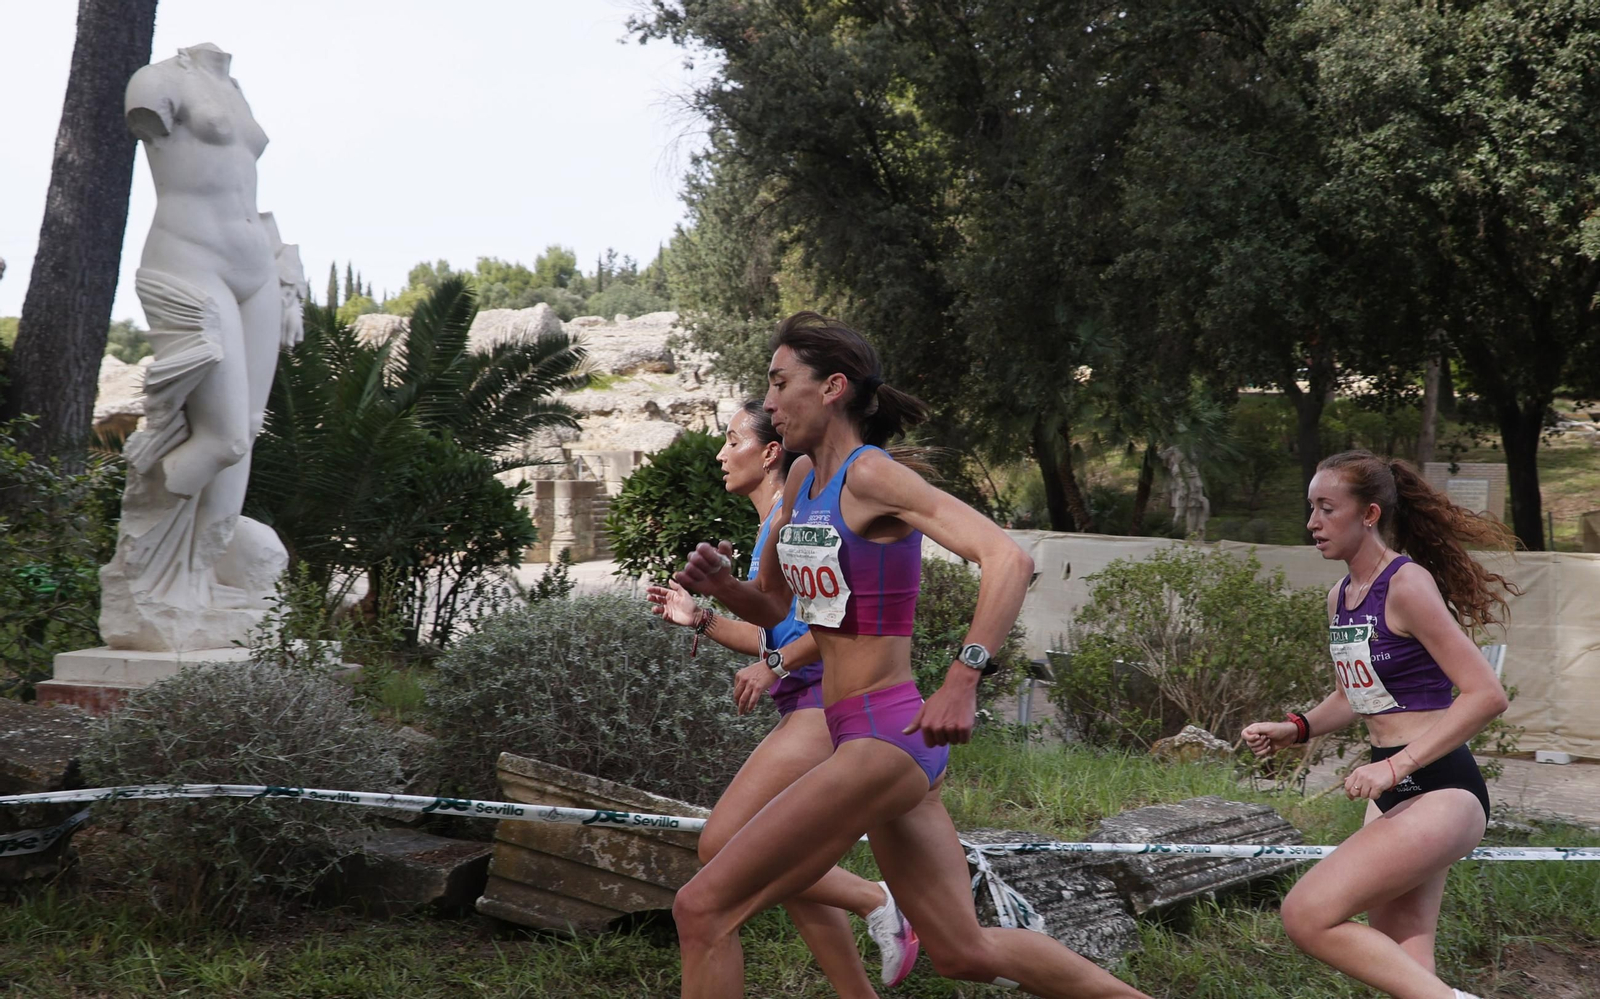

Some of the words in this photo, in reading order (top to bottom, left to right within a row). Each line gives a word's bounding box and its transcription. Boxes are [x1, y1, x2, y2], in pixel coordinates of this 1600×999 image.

[783, 563, 839, 600] 5000
[1371, 652, 1391, 662] oria
[1337, 660, 1373, 688] 010
[309, 791, 360, 803] Sevilla
[475, 803, 524, 816] Sevilla
[633, 814, 679, 828] Sevilla
[1055, 842, 1092, 852] Sevilla
[1176, 844, 1211, 853] Sevilla
[1289, 845, 1322, 855] Sevilla
